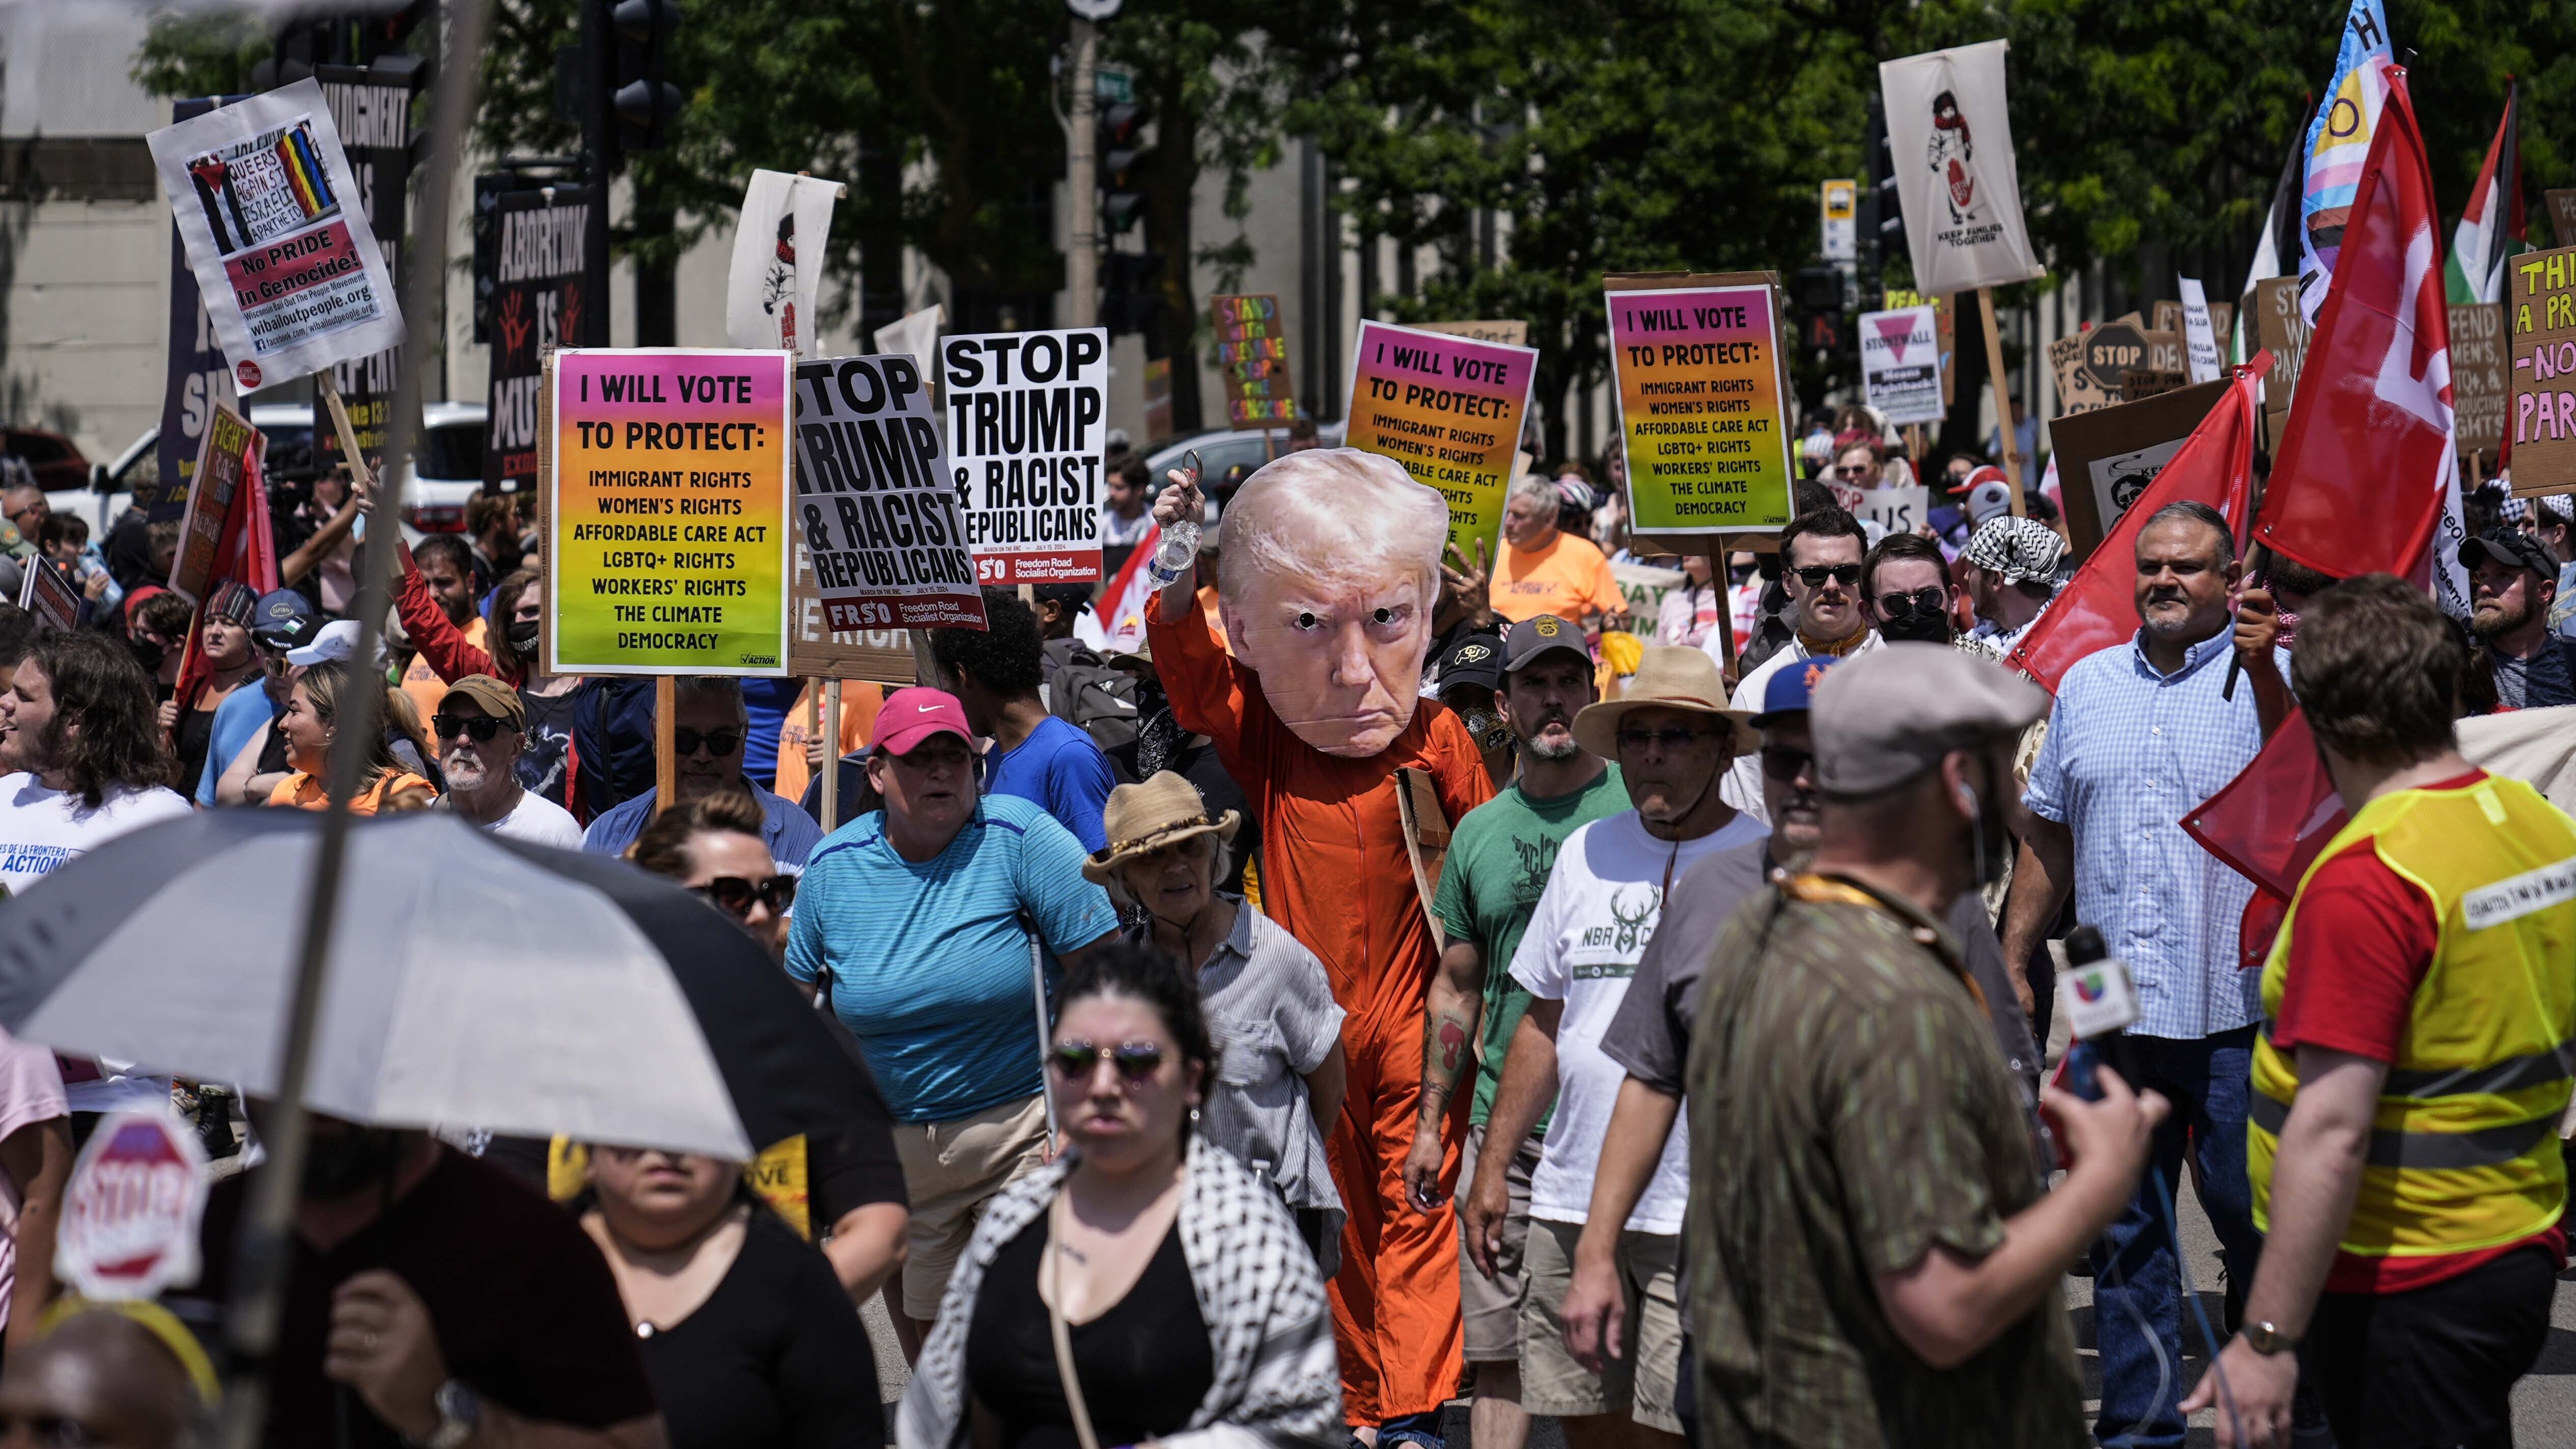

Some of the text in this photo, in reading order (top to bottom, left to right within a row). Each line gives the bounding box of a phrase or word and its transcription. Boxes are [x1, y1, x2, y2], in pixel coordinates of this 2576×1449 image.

[229, 149, 276, 182] QUEERS
[236, 165, 284, 204] AGAINST
[240, 186, 294, 223] ISRAELI
[251, 206, 301, 243] APARTHEID
[1938, 223, 2003, 241] KEEP FAMILIES
[498, 205, 588, 282] ABORTION
[1949, 233, 1996, 247] TOGETHER
[240, 230, 333, 276] No PRIDE
[236, 289, 257, 306] In
[259, 250, 359, 298] Genocide!
[244, 272, 366, 321] Wisconsin Bail Out The People Movement
[250, 285, 371, 336] wibailoutpeople.org
[1223, 297, 1274, 324] STAND
[1627, 306, 1746, 331] I WILL VOTE
[2515, 303, 2533, 335] A
[536, 290, 558, 361] IS
[1219, 337, 1285, 363] PALESTINE
[1865, 331, 1932, 351] STONEWALL
[946, 332, 1101, 388] STOP
[1376, 343, 1508, 385] I WILL VOTE
[1628, 342, 1759, 367] TO PROTECT:
[2093, 345, 2141, 366] STOP
[1235, 359, 1271, 379] STOP
[1883, 369, 1921, 381] Means
[581, 375, 751, 403] I WILL VOTE
[796, 358, 919, 419] TOP
[1243, 379, 1269, 396] THE
[1369, 377, 1510, 419] TO PROTECT:
[1641, 379, 1754, 395] IMMIGRANT RIGHTS
[1231, 398, 1293, 420] GENOCIDE
[1649, 400, 1750, 414] WOMEN'S RIGHTS
[950, 387, 1101, 457] TRUMP
[1373, 413, 1495, 446] IMMIGRANT RIGHTS
[1635, 419, 1769, 435] AFFORDABLE CARE ACT
[212, 413, 247, 457] FIGHT
[577, 421, 764, 450] TO PROTECT:
[1377, 434, 1484, 465] WOMEN'S RIGHTS
[1658, 440, 1751, 456] LGBTQ+ RIGHTS
[589, 470, 751, 489] IMMIGRANT RIGHTS
[1438, 468, 1498, 487] CARE ACT
[1652, 460, 1760, 475] WORKERS' RIGHTS
[955, 456, 1099, 509] & RACIST
[1670, 480, 1747, 495] THE CLIMATE
[598, 498, 742, 515] WOMEN'S RIGHTS
[1675, 501, 1746, 515] DEMOCRACY
[1829, 486, 1864, 513] TOP
[573, 524, 766, 543] AFFORDABLE CARE ACT
[803, 493, 964, 551] & RACIST
[963, 507, 1096, 545] EPUBLICANS
[603, 551, 735, 570] LGBTQ+ RIGHTS
[813, 548, 972, 588] REPUBLICANS
[1015, 558, 1072, 568] Freedom Road
[1015, 567, 1096, 579] Socialist Organization
[592, 578, 746, 596] WORKERS' RIGHTS
[614, 605, 721, 623] THE CLIMATE
[830, 602, 891, 626] FRSO
[899, 601, 959, 613] Freedom Road
[903, 611, 983, 624] Socialist Organization
[618, 632, 718, 649] DEMOCRACY
[9, 844, 18, 854] DE
[19, 844, 27, 855] LA
[30, 845, 67, 857] FRONTERA
[2, 855, 64, 874] ACTION
[1582, 927, 1613, 947] NBA
